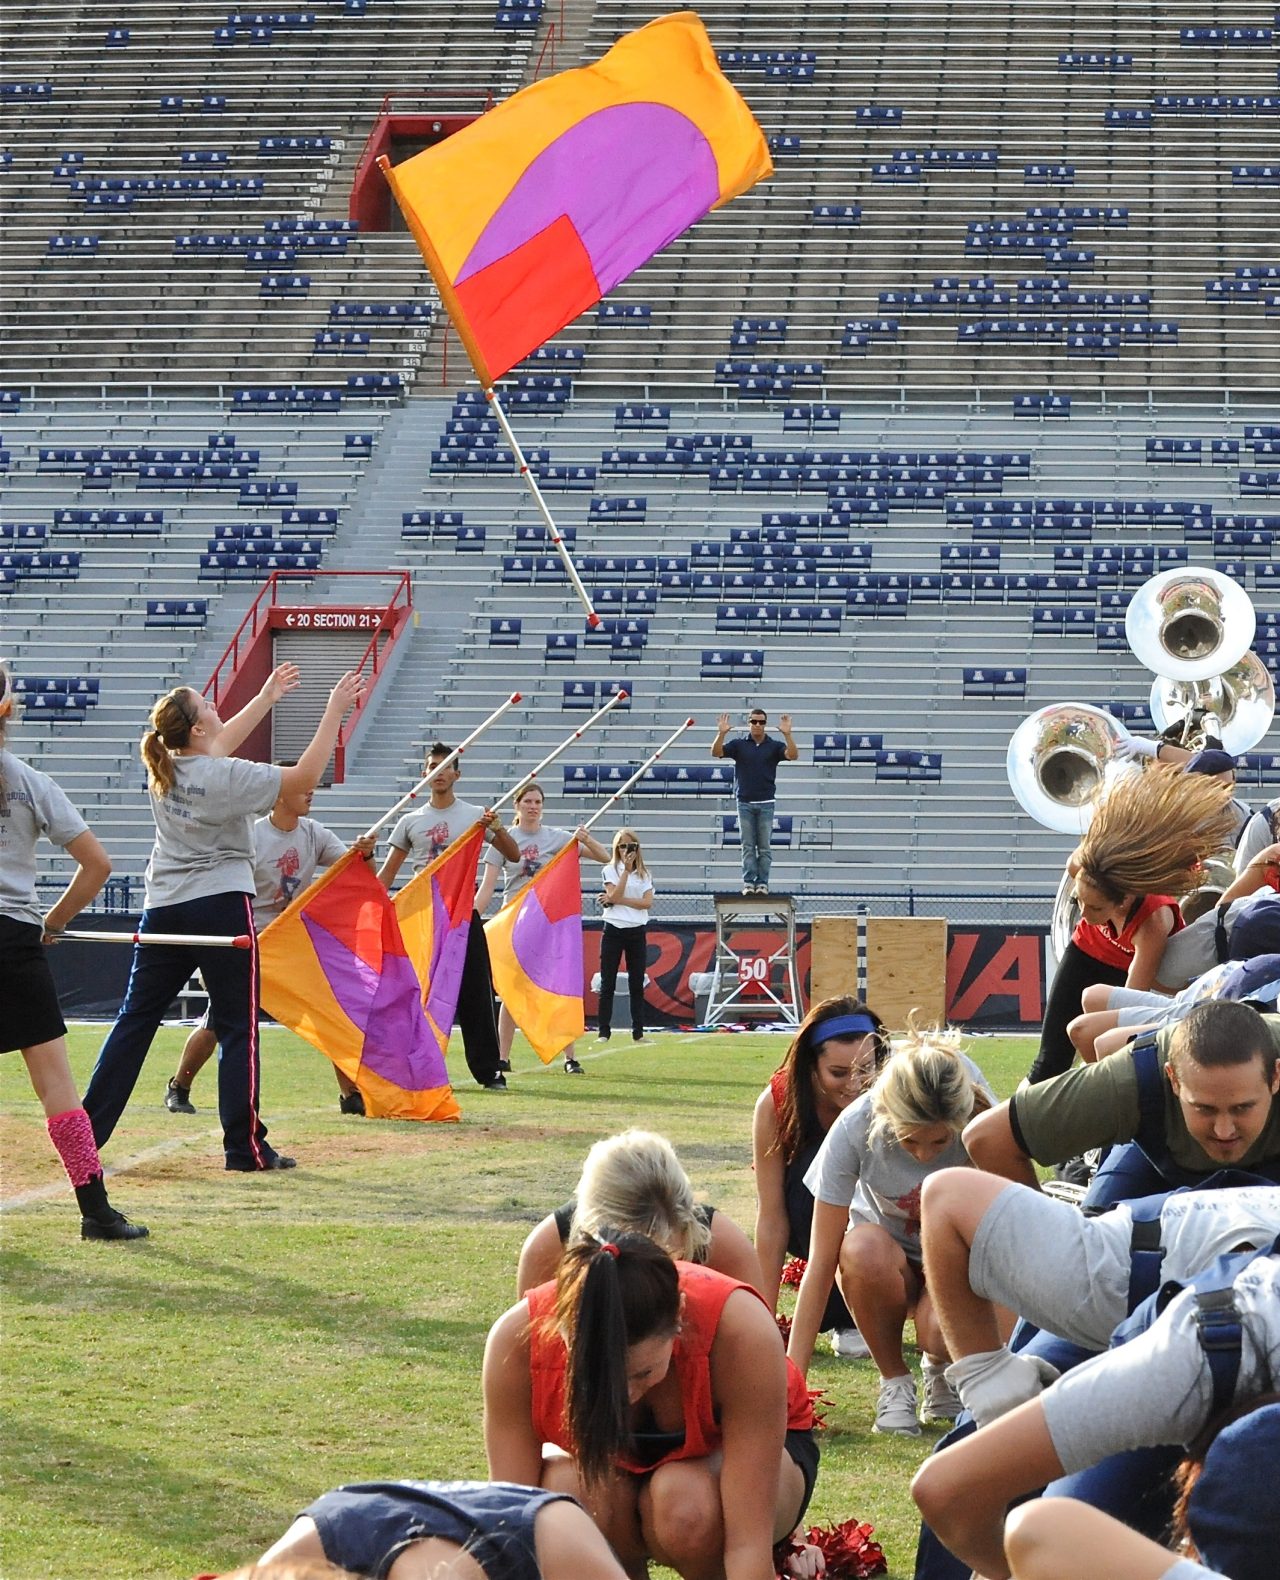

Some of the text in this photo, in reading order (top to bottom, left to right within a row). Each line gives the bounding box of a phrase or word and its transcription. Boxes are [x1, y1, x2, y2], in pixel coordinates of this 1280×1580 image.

[296, 614, 370, 627] 20 SECTION 21
[740, 958, 767, 980] 50
